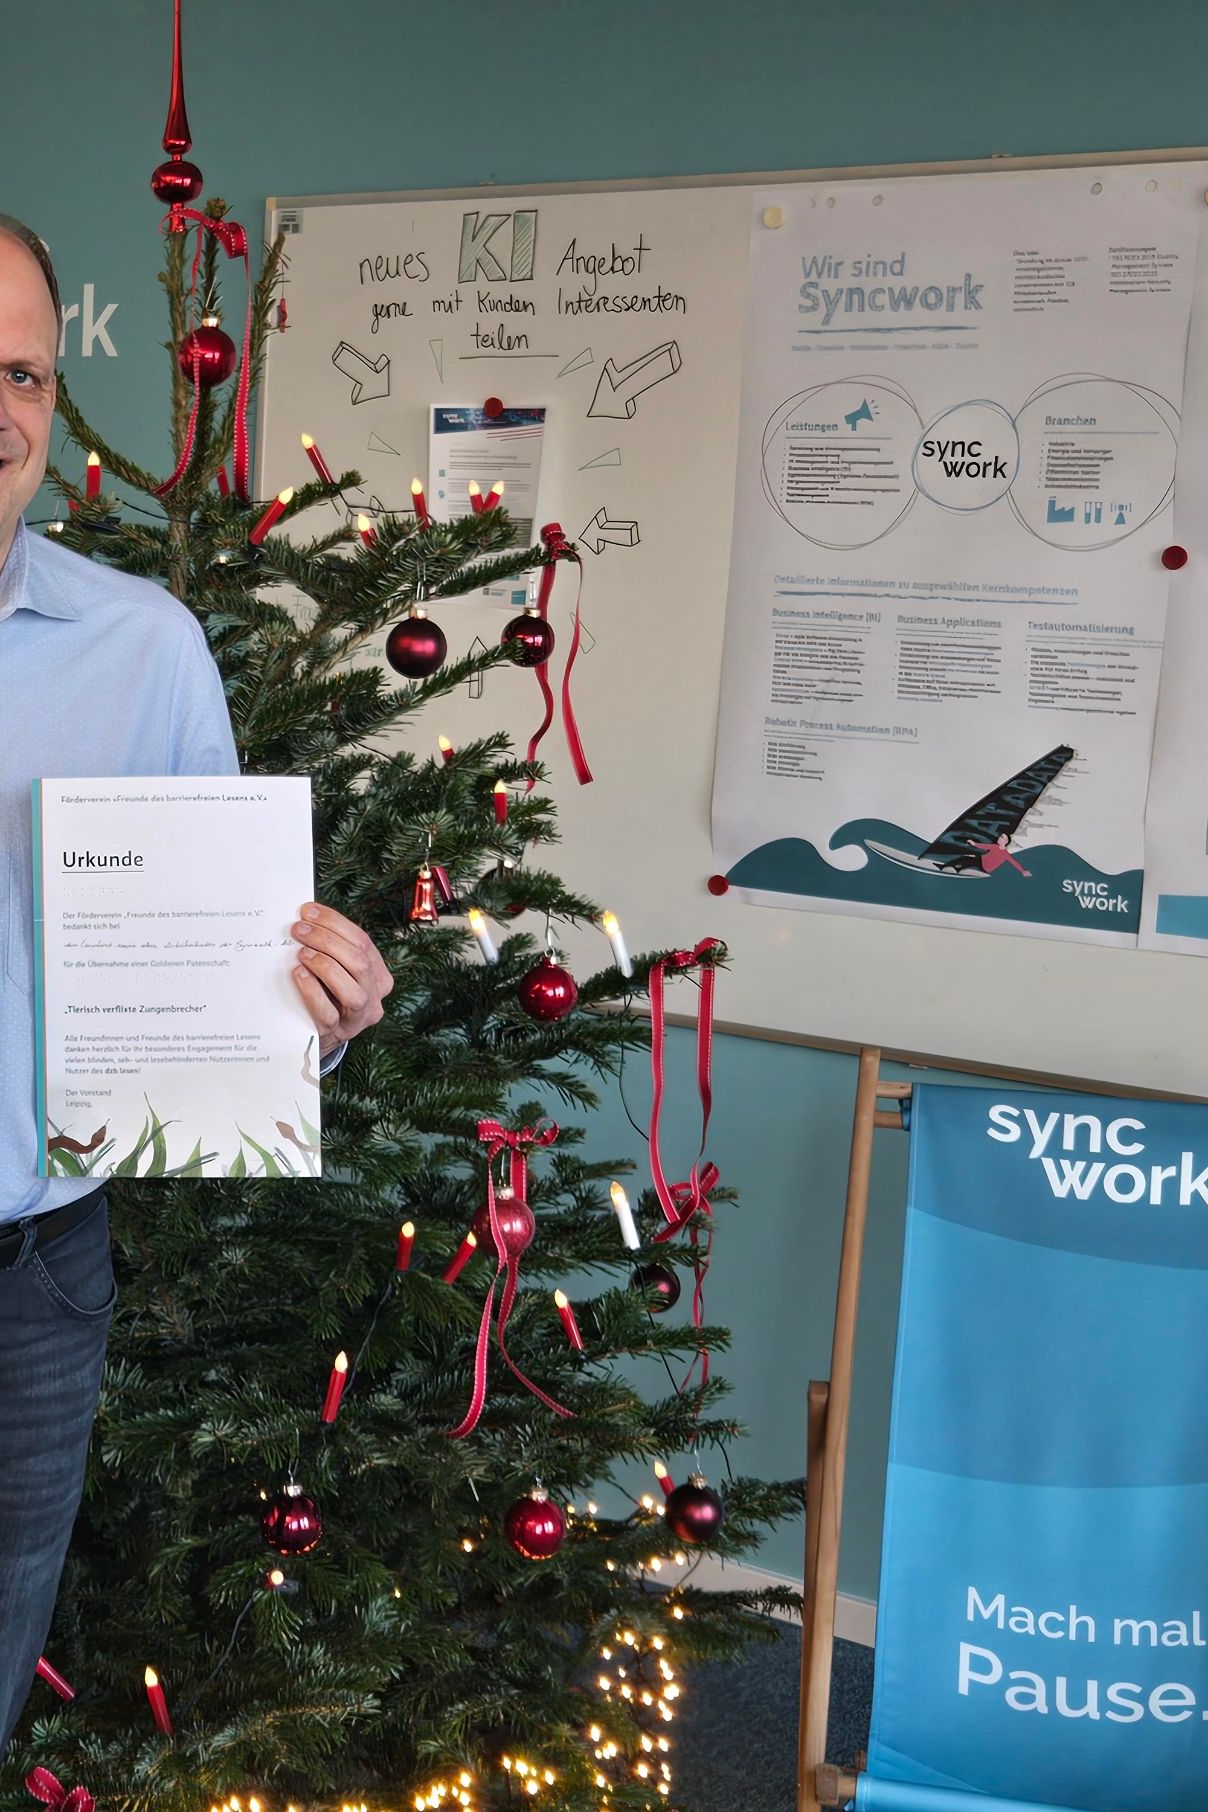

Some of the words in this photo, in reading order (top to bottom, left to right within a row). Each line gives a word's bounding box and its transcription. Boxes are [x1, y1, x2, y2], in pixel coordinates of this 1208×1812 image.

[359, 252, 430, 285] neues
[458, 210, 538, 284] KI
[556, 233, 652, 296] Angebot
[801, 255, 845, 279] Wir
[851, 252, 906, 278] sind
[798, 272, 985, 326] Syncwork
[371, 301, 414, 334] gerne
[432, 290, 463, 314] mit
[477, 290, 535, 316] Kunden
[558, 285, 686, 315] Interessenten
[57, 283, 119, 357] rk
[470, 322, 529, 351] teilen
[785, 421, 839, 433] Leistungen
[1045, 415, 1097, 426] Branchen
[922, 440, 983, 462] sync
[943, 456, 1008, 478] work
[827, 576, 896, 589] Informationen
[772, 608, 811, 618] Business
[812, 610, 864, 622] Intelligence
[897, 614, 938, 625] Business
[940, 617, 1002, 629] Applications
[1028, 620, 1135, 635] Testautomatisierung
[764, 717, 797, 728] Robotic
[799, 719, 833, 730] Process
[836, 722, 891, 734] Automation
[151, 794, 164, 802] des
[166, 793, 221, 802] barrierefreien
[222, 793, 248, 802] Lesens
[63, 850, 144, 868] Urkunde
[1062, 879, 1109, 897] sync
[1078, 894, 1129, 913] work
[77, 911, 122, 919] Förderverein
[93, 922, 108, 930] sich
[75, 960, 86, 968] die
[87, 959, 129, 968] Übernahme
[102, 1004, 137, 1013] verflixte
[80, 1034, 124, 1042] Freundinnen
[187, 1045, 232, 1053] Engagement
[134, 1056, 149, 1064] und
[150, 1056, 208, 1064] lesebehinderten
[986, 1104, 1146, 1159] sync
[1041, 1152, 1208, 1206] work
[966, 1585, 1096, 1643] Mach
[1113, 1610, 1207, 1647] mal
